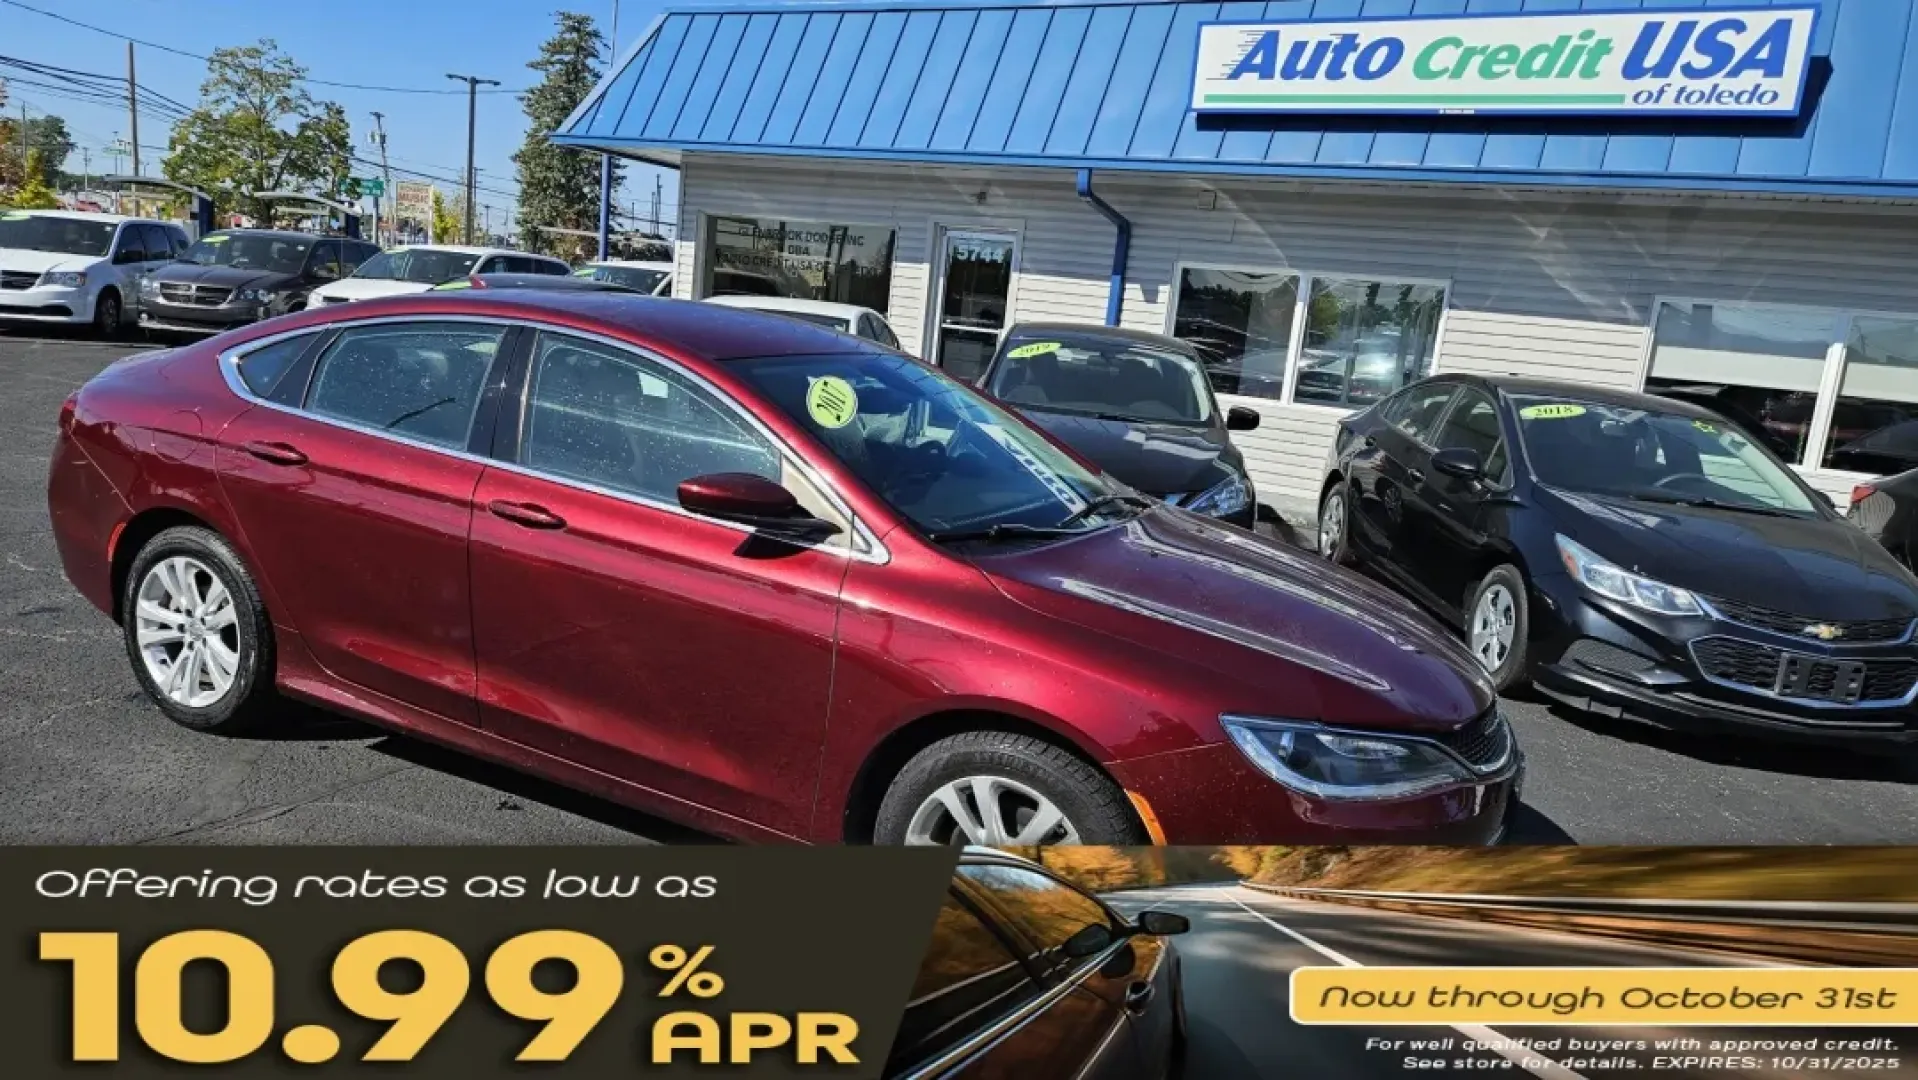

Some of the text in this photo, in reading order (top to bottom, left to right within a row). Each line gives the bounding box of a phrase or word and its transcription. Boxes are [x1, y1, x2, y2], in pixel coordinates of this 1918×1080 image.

[1226, 19, 1794, 81] Auto Credit USA
[1632, 82, 1780, 106] of toledo
[957, 244, 1004, 264] 5744
